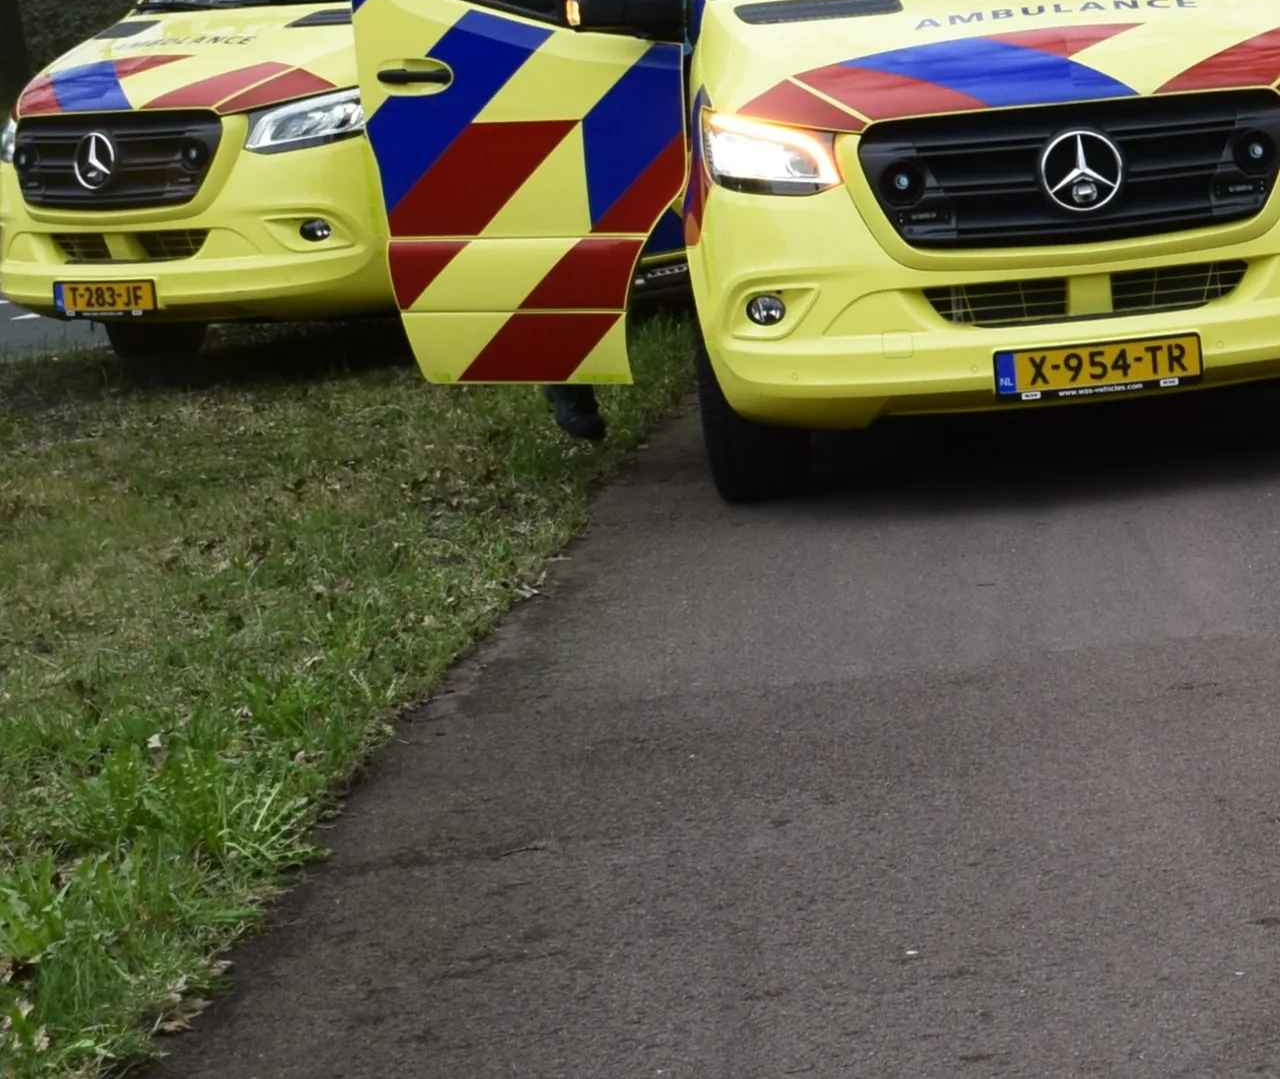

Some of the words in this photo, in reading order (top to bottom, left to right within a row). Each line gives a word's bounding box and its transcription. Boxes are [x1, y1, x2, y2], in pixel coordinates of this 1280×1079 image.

[114, 35, 257, 51] AMBULANCE
[68, 286, 142, 308] T-283-JF
[999, 377, 1014, 387] NL
[1028, 343, 1188, 386] X-954-TR
[1058, 382, 1144, 397] www.was-vehicles.com
